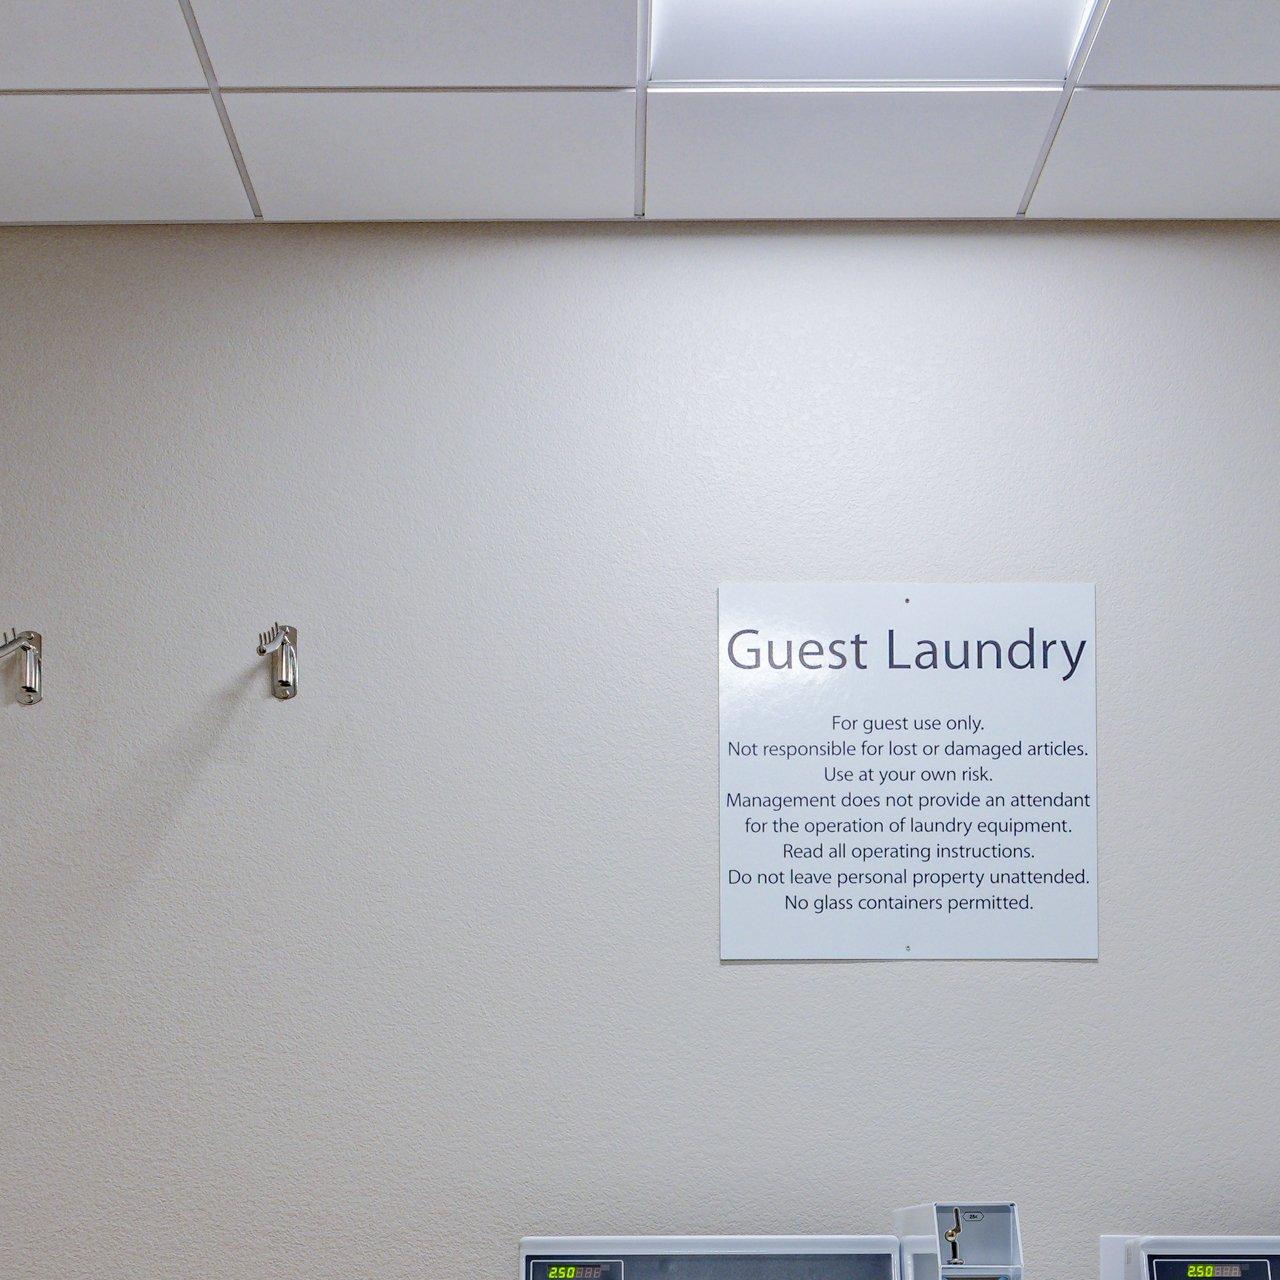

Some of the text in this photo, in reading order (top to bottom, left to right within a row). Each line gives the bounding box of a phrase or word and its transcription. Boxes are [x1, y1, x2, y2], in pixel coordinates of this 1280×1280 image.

[728, 627, 1087, 681] Guest Laundry
[832, 715, 984, 734] For guest use only.
[728, 740, 1088, 760] Not responsible for lost or damaged articles.
[824, 766, 992, 785] Use at your own risk.
[726, 792, 1090, 812] Management does not provide an attendant
[744, 816, 1072, 837] for the operation of laundry equipment.
[783, 843, 1034, 862] Read all operating instructions.
[728, 868, 1089, 888] Do not leave personal property unattended.
[784, 894, 1033, 914] No glass containers permitted.
[548, 1267, 576, 1279] 2.50
[1187, 1265, 1213, 1277] 2.50
